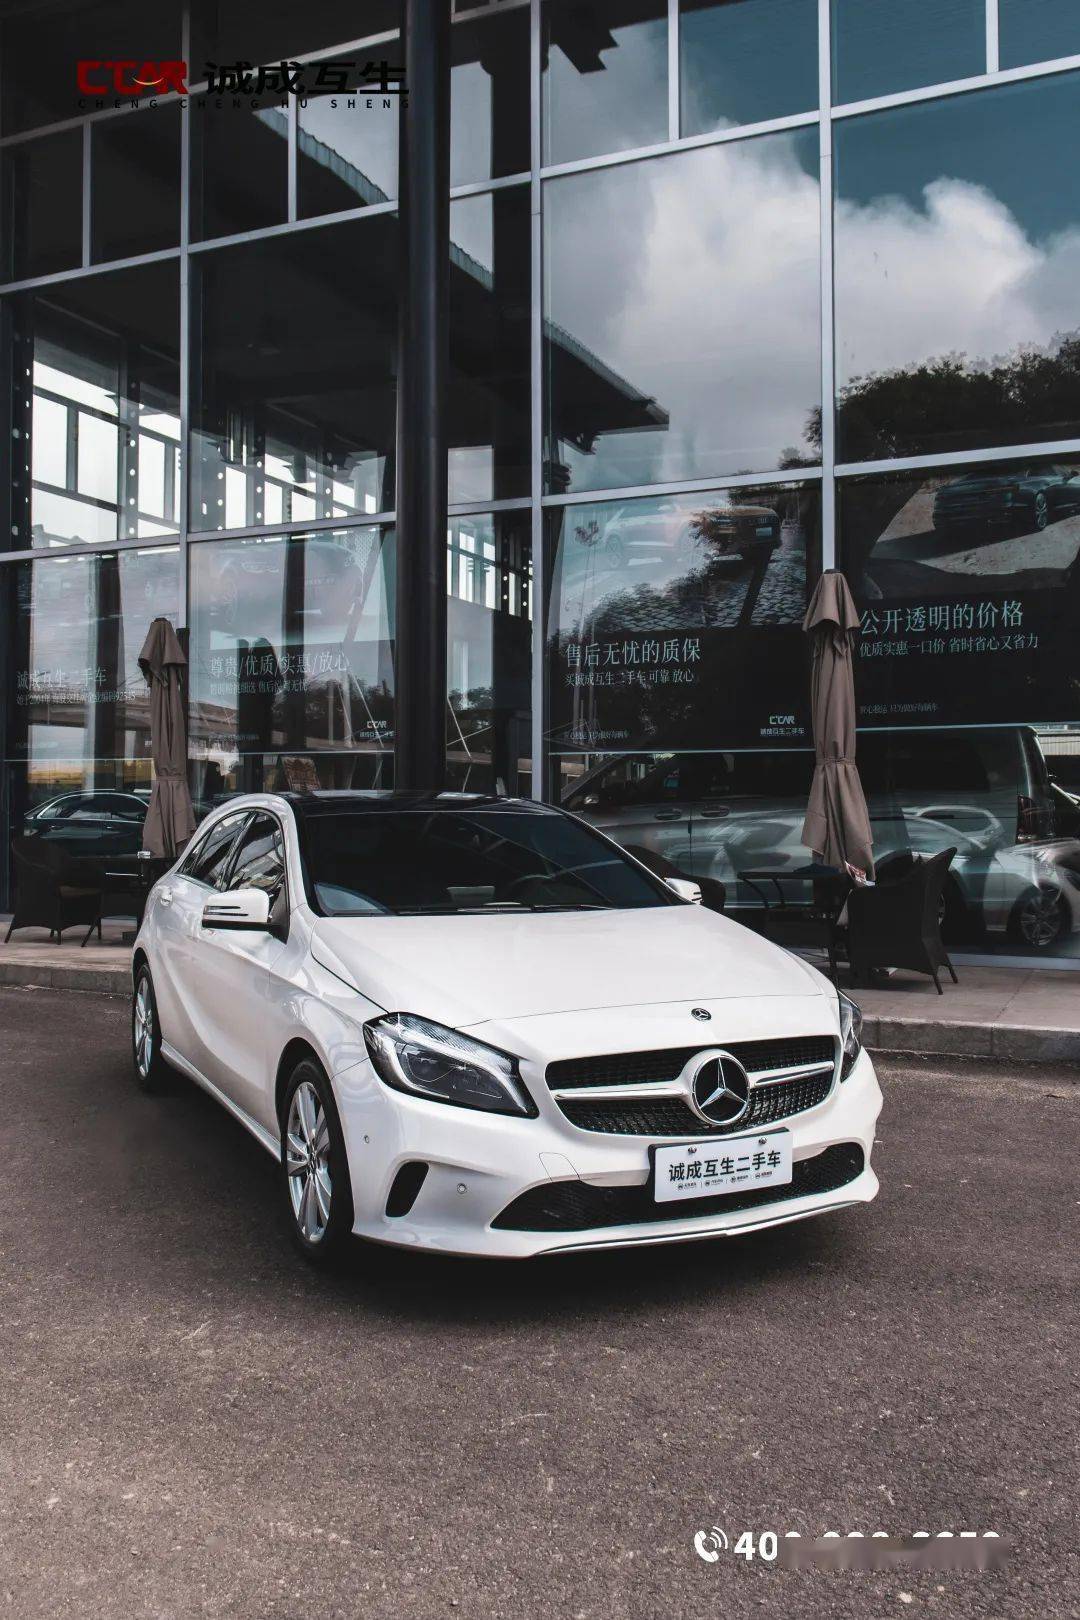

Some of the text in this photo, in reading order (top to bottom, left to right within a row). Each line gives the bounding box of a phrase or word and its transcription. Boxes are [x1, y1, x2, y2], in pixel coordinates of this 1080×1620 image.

[860, 600, 1024, 635] 公开透明的价格
[566, 637, 701, 667] 售后无忧的质保
[860, 633, 1040, 657] 优质实惠一口价 省时省心又省力
[668, 1150, 781, 1182] 诚成互生二手车
